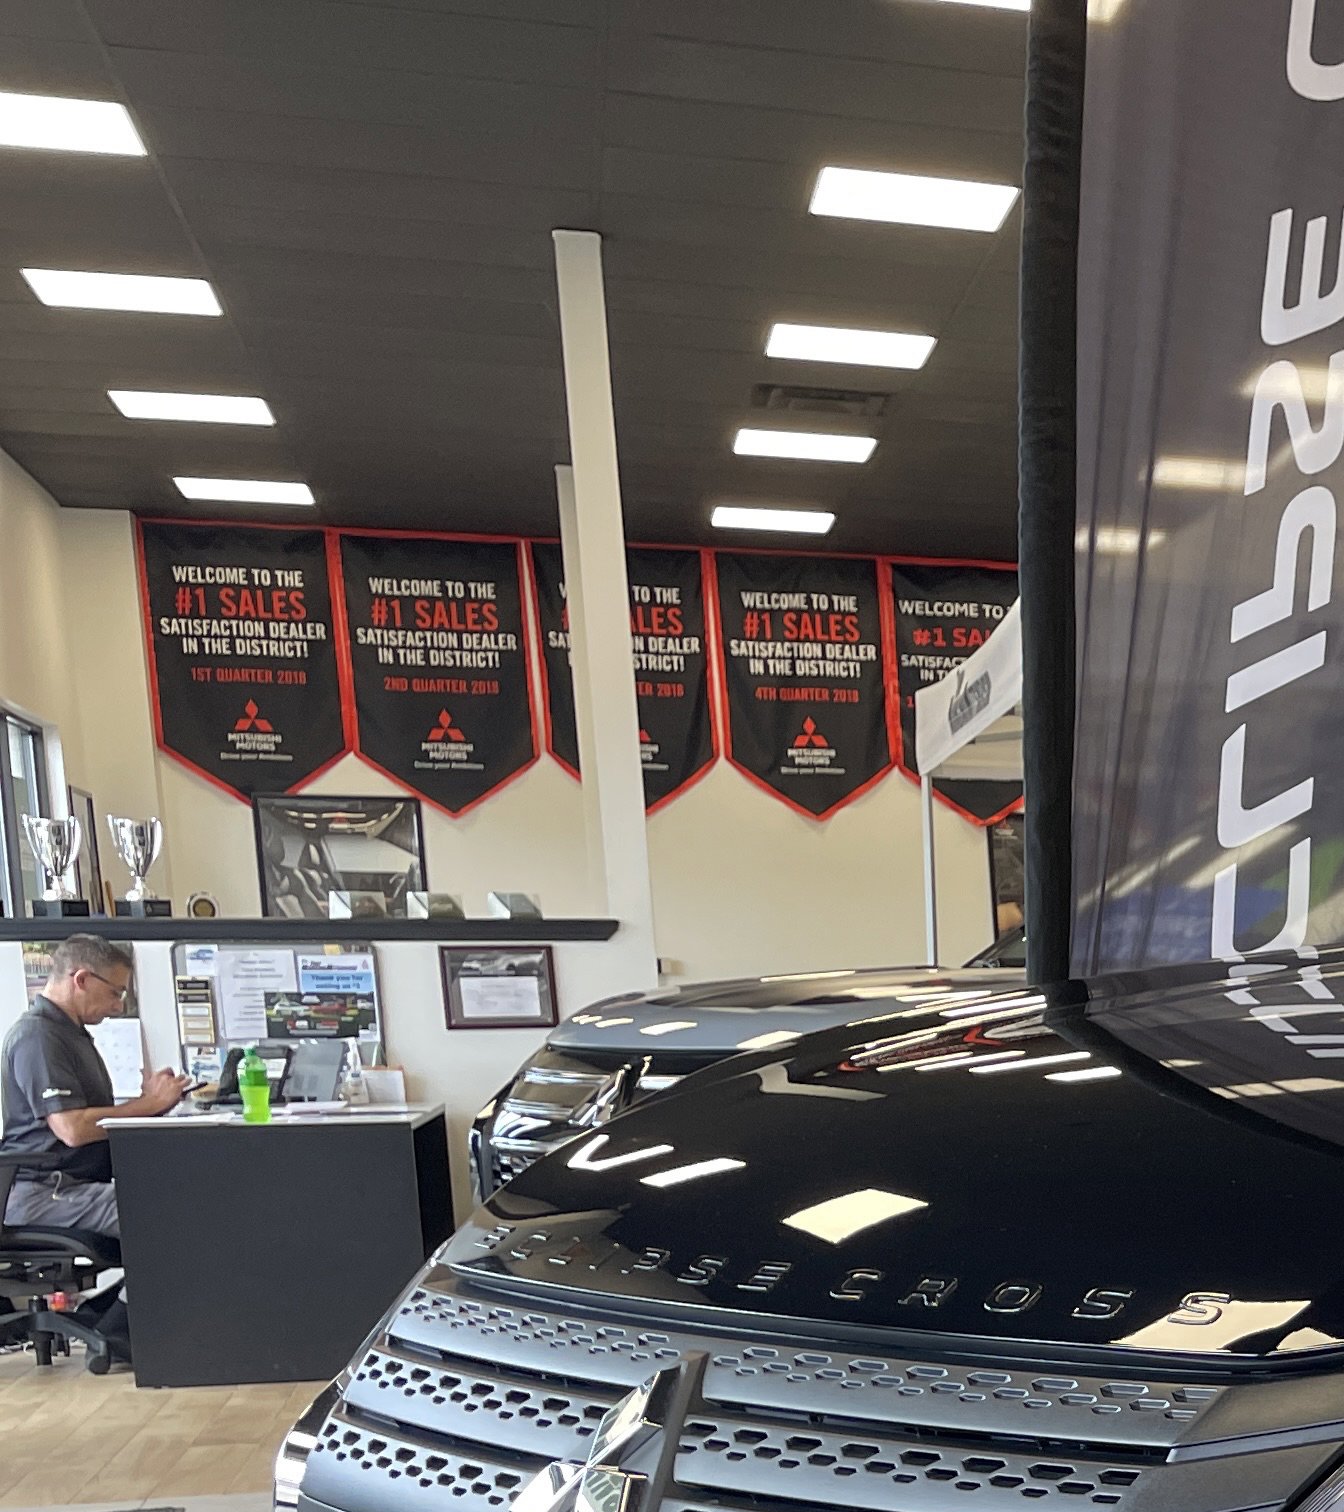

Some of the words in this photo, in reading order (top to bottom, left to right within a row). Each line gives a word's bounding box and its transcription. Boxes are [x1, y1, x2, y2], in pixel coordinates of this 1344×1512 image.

[172, 565, 248, 585] WELCOME
[252, 568, 271, 586] TO
[275, 569, 304, 587] THE
[368, 577, 442, 597] WELCOME
[445, 581, 464, 598] TO
[468, 582, 496, 599] THE
[632, 585, 650, 603] TO
[654, 587, 681, 605] THE
[175, 586, 206, 616] #1
[218, 587, 307, 620] SALES
[741, 591, 808, 609] WELCOME
[811, 593, 829, 610] TO
[832, 595, 857, 612] THE
[899, 600, 978, 617] WELCOME
[982, 603, 1003, 619] TO
[371, 598, 402, 627] #1
[415, 600, 499, 631] SALES
[160, 617, 265, 637] SATISFACTION
[269, 622, 326, 640] DEALER
[744, 611, 772, 640] #1
[783, 612, 860, 642] SALES
[913, 626, 946, 647] #1
[182, 638, 198, 654] IN
[202, 639, 232, 655] THE
[235, 640, 309, 658] DISTRICT!
[356, 627, 458, 649] SATISFACTION
[462, 632, 517, 650] DEALER
[649, 637, 700, 654] DEALER
[378, 648, 393, 664] IN
[398, 649, 426, 665] THE
[429, 650, 500, 668] DISTRICT!
[730, 639, 822, 659] SATISFACTION
[826, 644, 876, 660] DEALER
[191, 667, 212, 681] 1ST
[217, 668, 273, 682] QUARTER
[750, 659, 765, 675] IN
[767, 660, 792, 676] THE
[795, 661, 861, 678] DISTRICT!
[920, 670, 934, 681] IN
[384, 676, 408, 691] 2ND
[412, 678, 468, 693] QUARTER
[756, 687, 776, 701] 4TH
[780, 688, 829, 702] QUARTER
[829, 1268, 1231, 1325] CROSS
